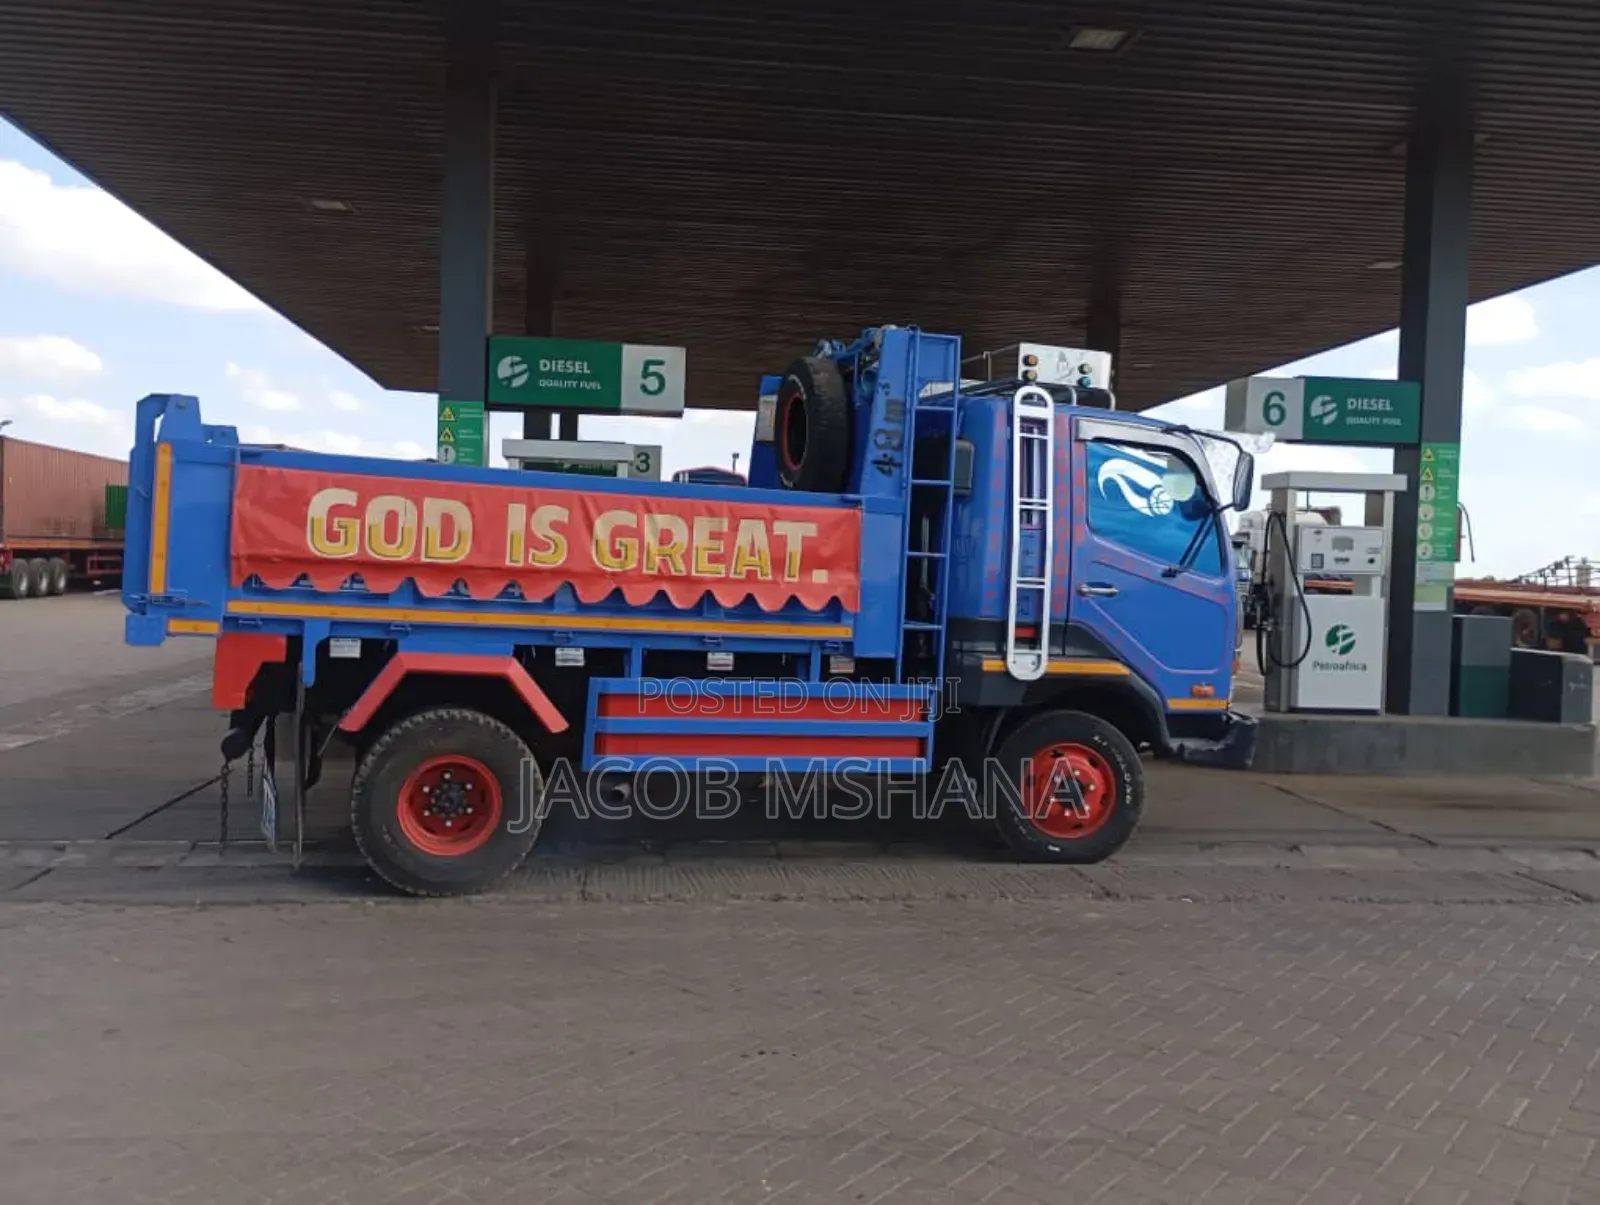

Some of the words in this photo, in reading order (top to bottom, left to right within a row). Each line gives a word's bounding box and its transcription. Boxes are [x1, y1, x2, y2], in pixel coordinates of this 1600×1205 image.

[539, 359, 591, 374] DIESEL
[539, 379, 578, 389] QUALITY
[579, 380, 602, 391] FUEL
[640, 359, 665, 395] 5
[1262, 391, 1287, 426] 6
[1347, 398, 1393, 411] DIESEL
[1345, 415, 1380, 425] QUALITY
[635, 451, 651, 474] 3
[306, 486, 474, 565] GOD
[505, 502, 569, 569] IS
[591, 508, 831, 584] GREAT.
